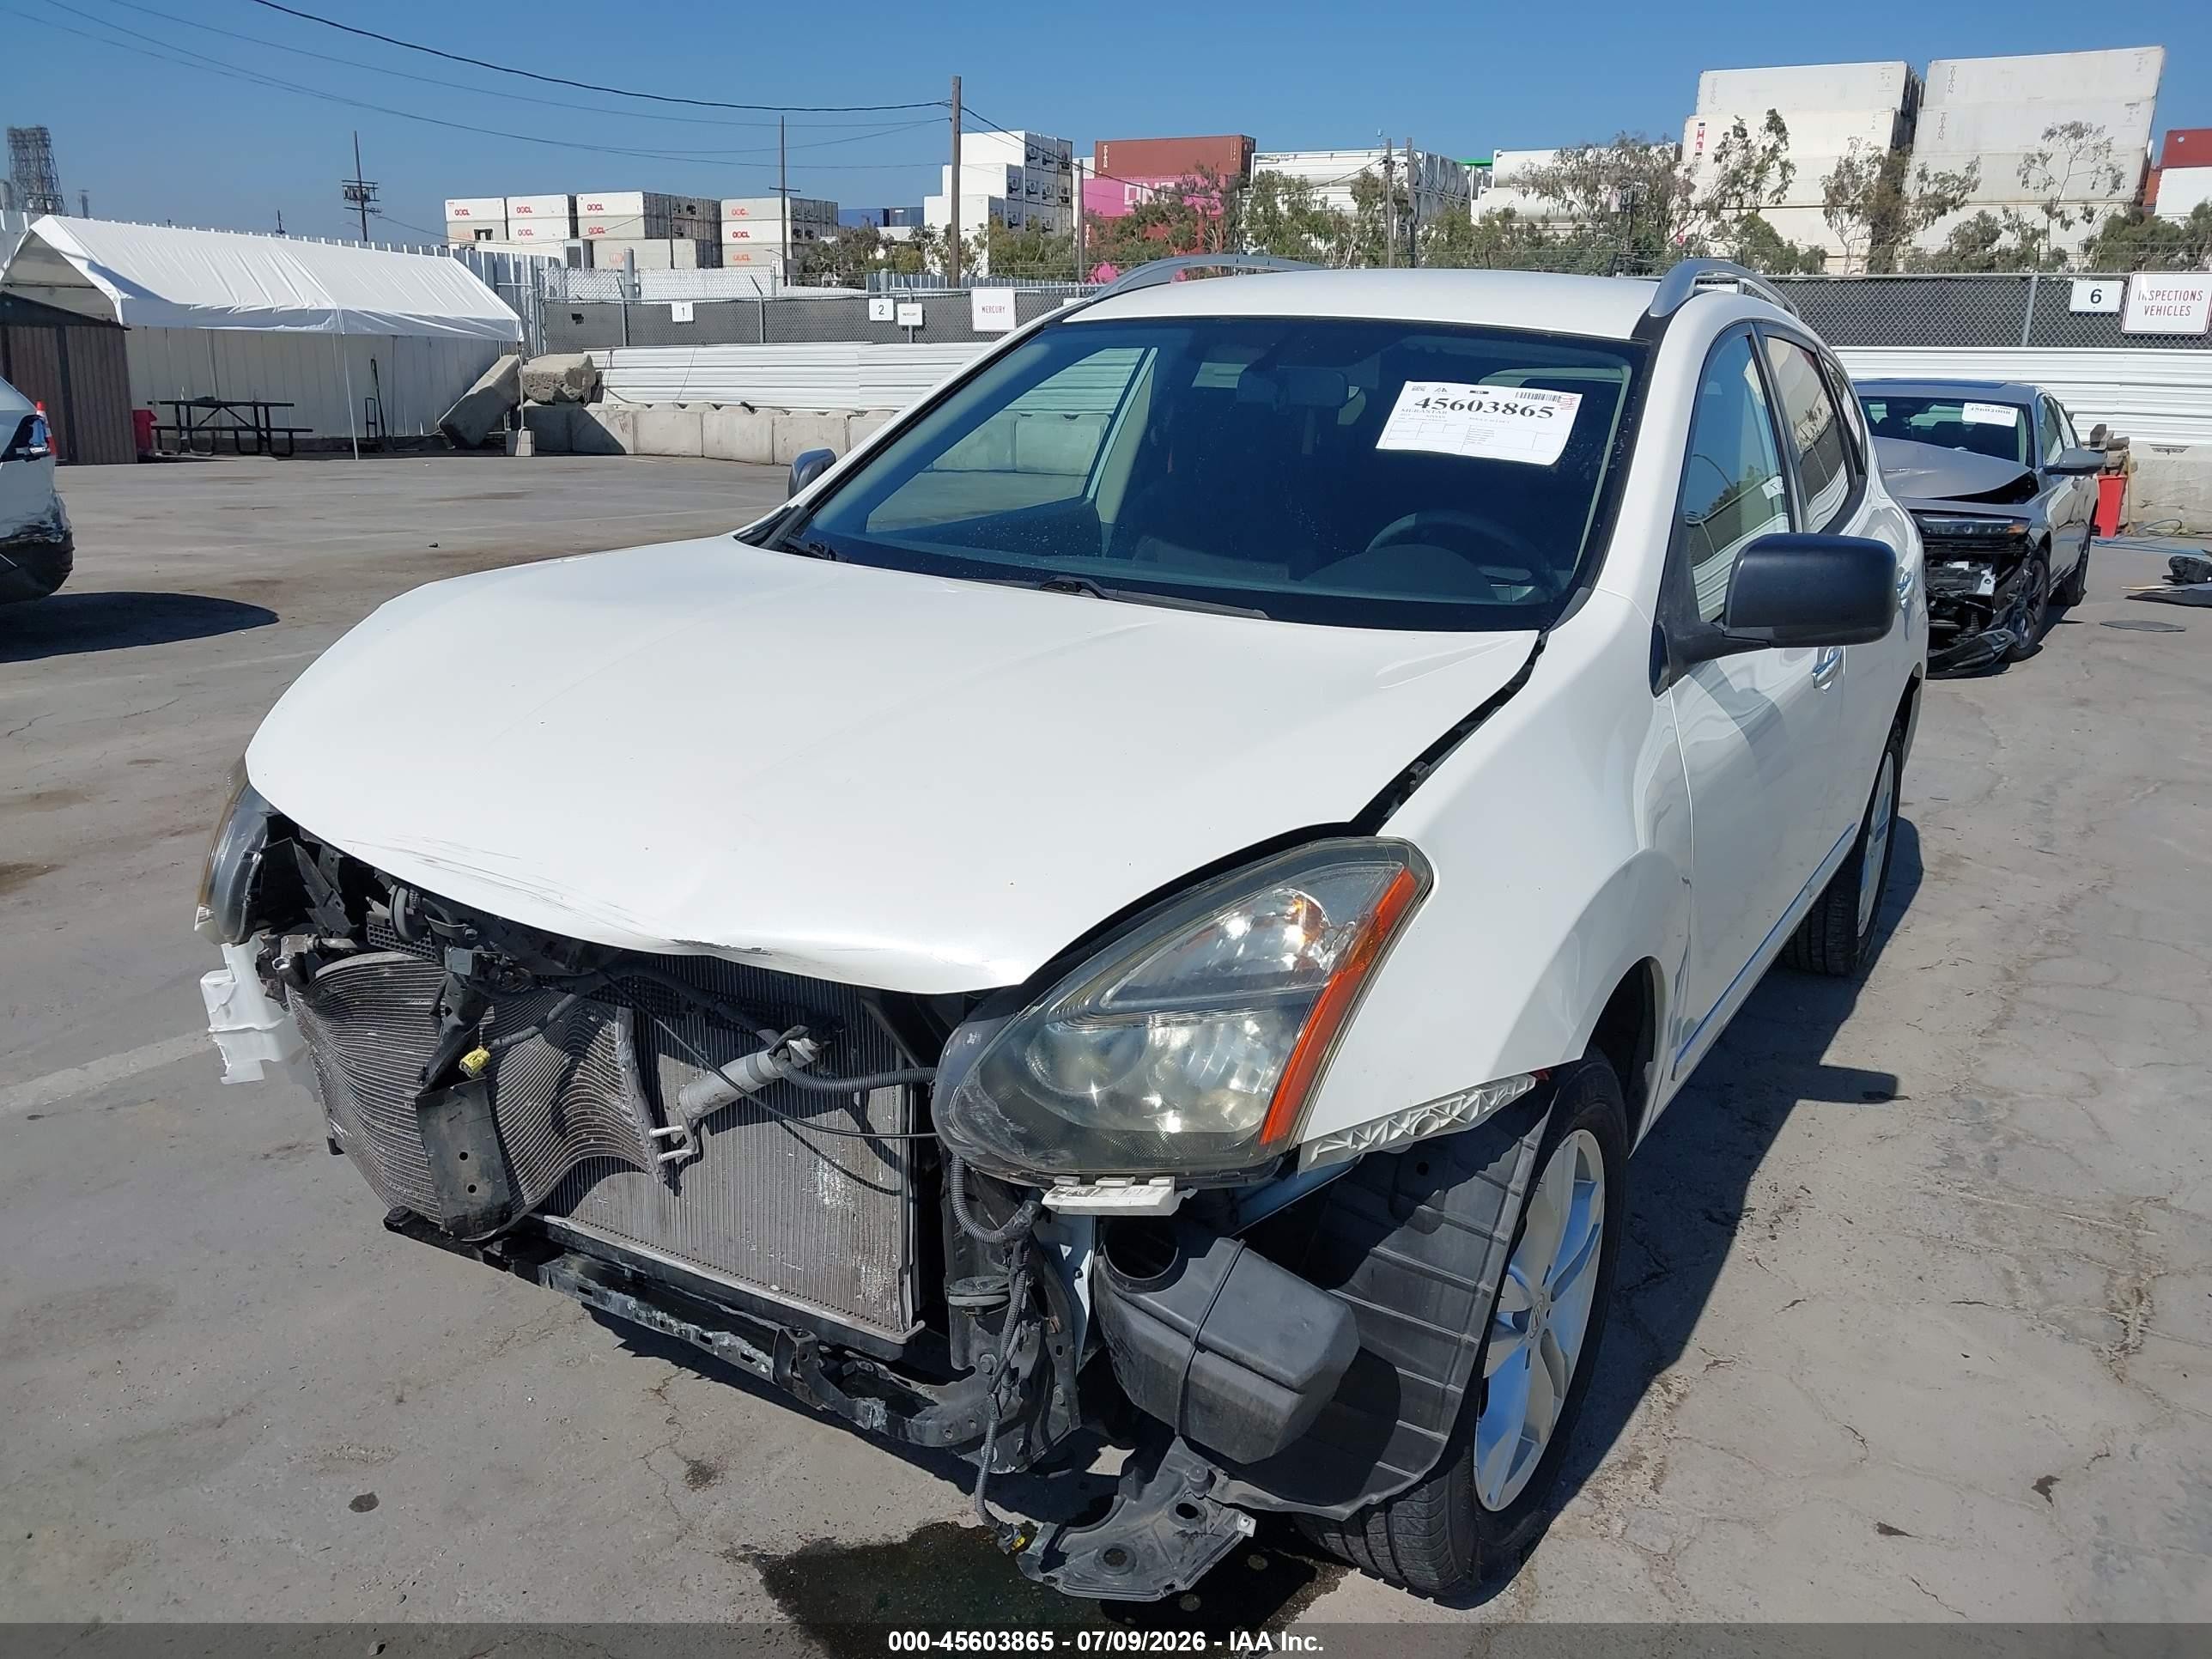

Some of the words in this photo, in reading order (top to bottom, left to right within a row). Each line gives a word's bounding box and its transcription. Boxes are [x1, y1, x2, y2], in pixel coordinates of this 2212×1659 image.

[2090, 289, 2103, 304] 6
[681, 307, 685, 317] 1
[878, 304, 885, 315] 2
[981, 305, 1006, 313] MERCURY
[2144, 306, 2192, 316] VEHICLES
[1414, 398, 1555, 419] 45603865
